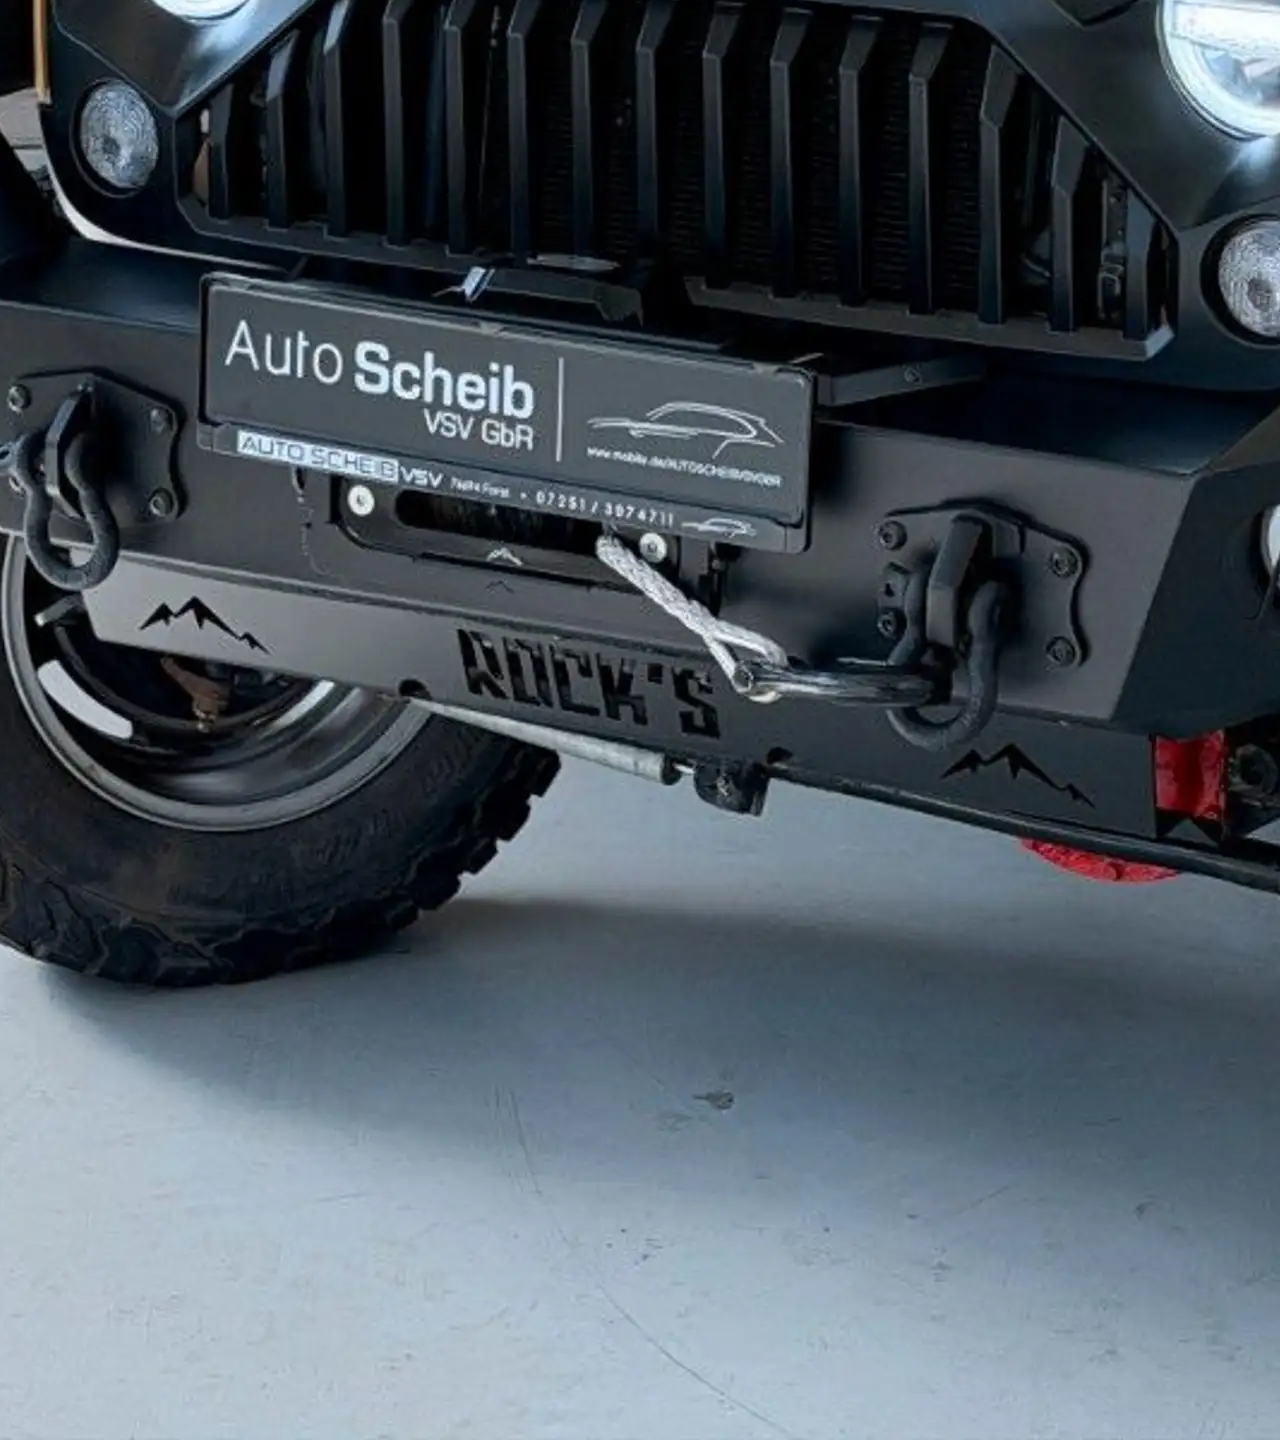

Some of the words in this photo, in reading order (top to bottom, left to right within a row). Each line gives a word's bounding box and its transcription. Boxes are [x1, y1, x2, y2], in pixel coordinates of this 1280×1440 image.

[225, 320, 343, 385] Auto
[354, 341, 535, 419] Scheib
[424, 409, 475, 440] VSV
[481, 419, 534, 452] GbR
[242, 435, 305, 461] AUTO
[400, 465, 444, 489] VSV
[535, 490, 586, 513] 07251
[457, 628, 720, 739] ROCK'S
